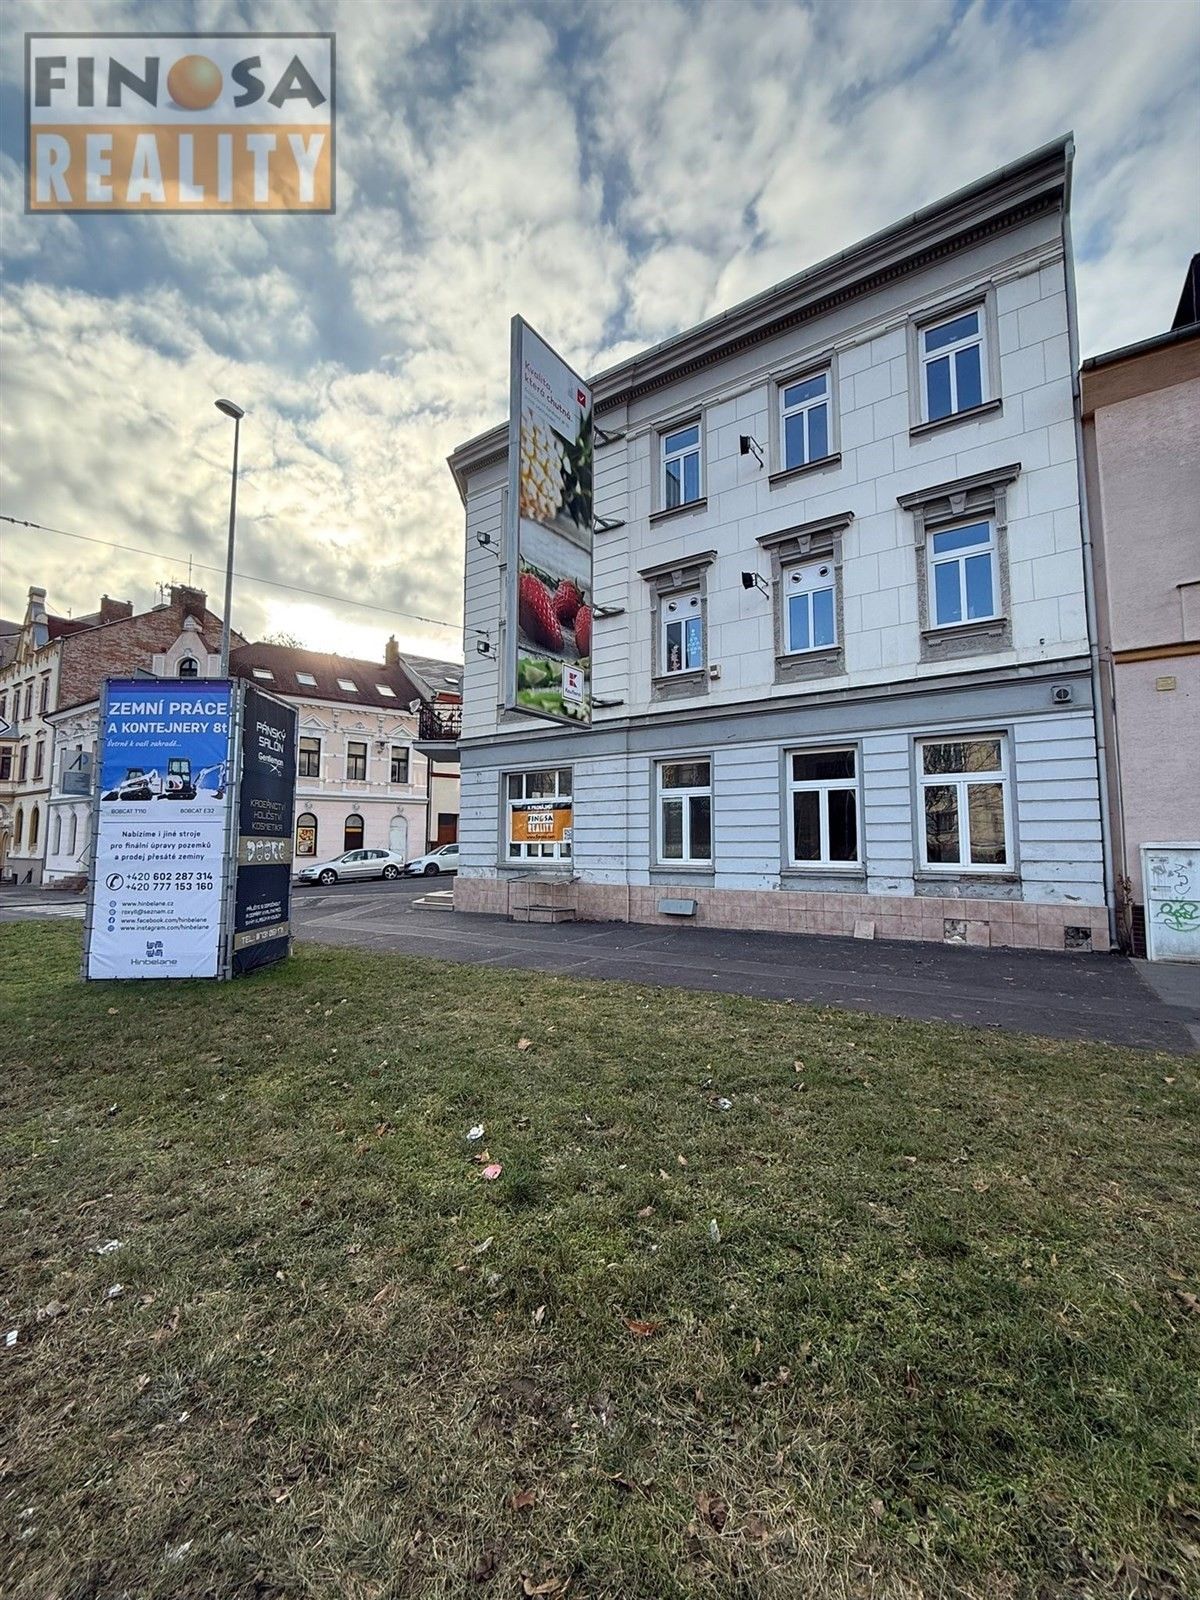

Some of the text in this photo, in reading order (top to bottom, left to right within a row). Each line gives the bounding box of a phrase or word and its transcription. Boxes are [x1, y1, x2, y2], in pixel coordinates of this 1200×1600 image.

[109, 699, 228, 715] ZEMNÍ PRÁCE
[107, 722, 228, 733] A KONTEJNERY 8t
[256, 720, 287, 742] PÁNSKÝ
[258, 735, 284, 754] SALÓN
[163, 831, 177, 839] jiné
[179, 831, 201, 839] stroje
[150, 842, 176, 850] úpravy
[178, 841, 212, 850] pozemků
[121, 853, 145, 861] prodej
[147, 853, 176, 861] přesáté
[178, 852, 205, 861] zeminy
[126, 873, 150, 881] +420
[153, 873, 172, 881] 602
[196, 872, 213, 880] 314
[126, 883, 150, 891] +420
[153, 883, 172, 891] 777
[175, 883, 193, 891] 153
[120, 924, 210, 932] www.instagram.com/hinbelane
